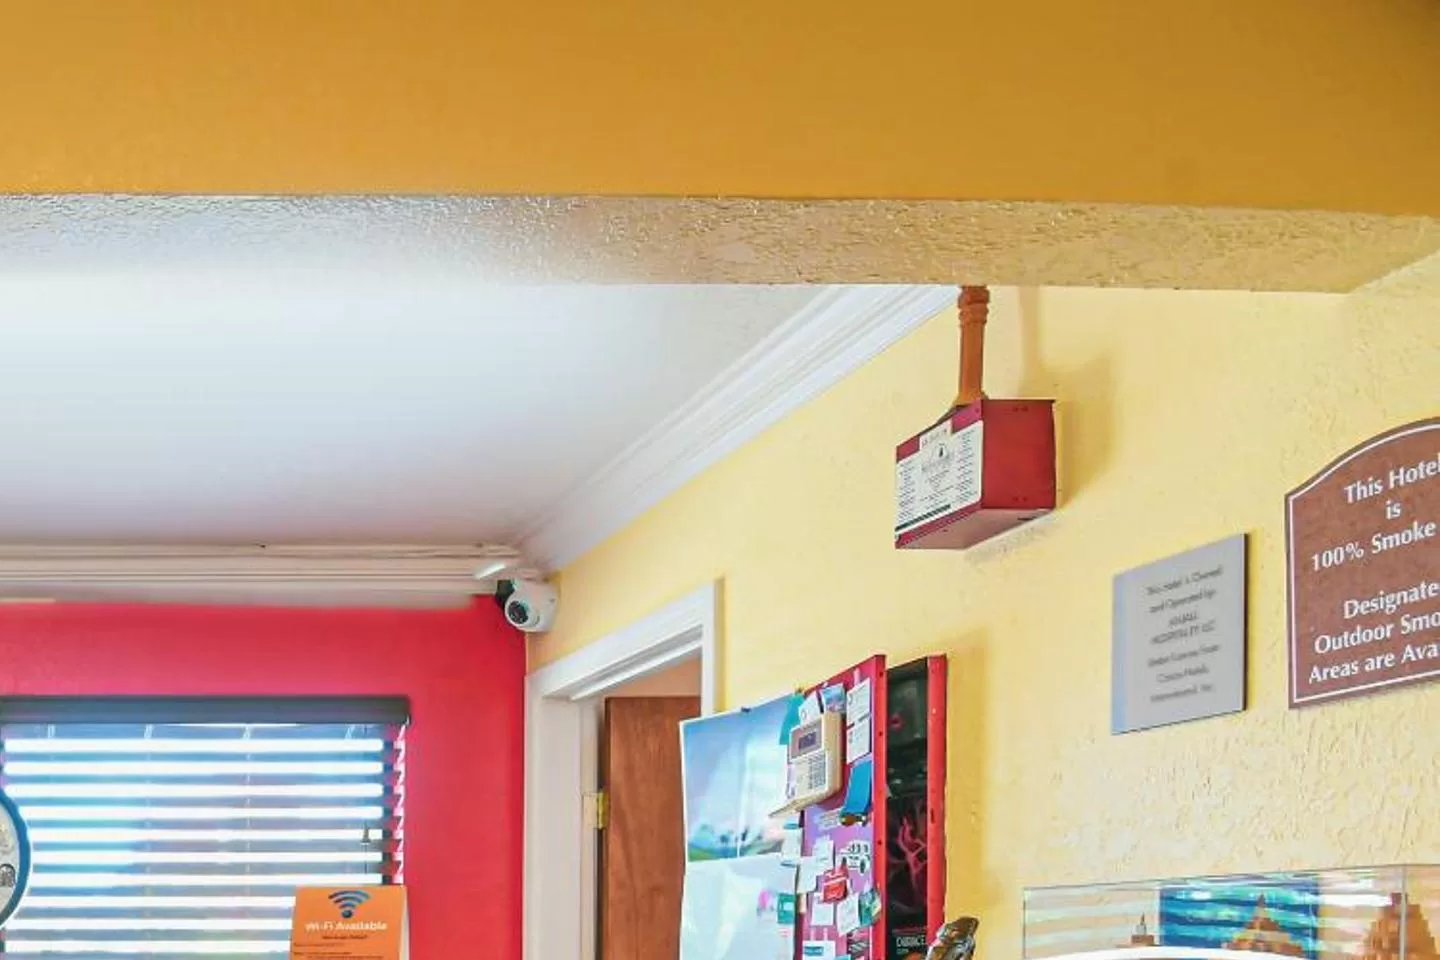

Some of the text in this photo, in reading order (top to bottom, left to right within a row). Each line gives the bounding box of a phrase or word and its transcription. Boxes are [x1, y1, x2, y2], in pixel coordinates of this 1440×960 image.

[1344, 451, 1440, 504] This Hotel
[1385, 499, 1402, 520] is
[1311, 520, 1437, 571] 100% Smoke
[1314, 623, 1395, 654] Outdoor
[1309, 660, 1359, 685] Areas
[1364, 652, 1395, 672] are
